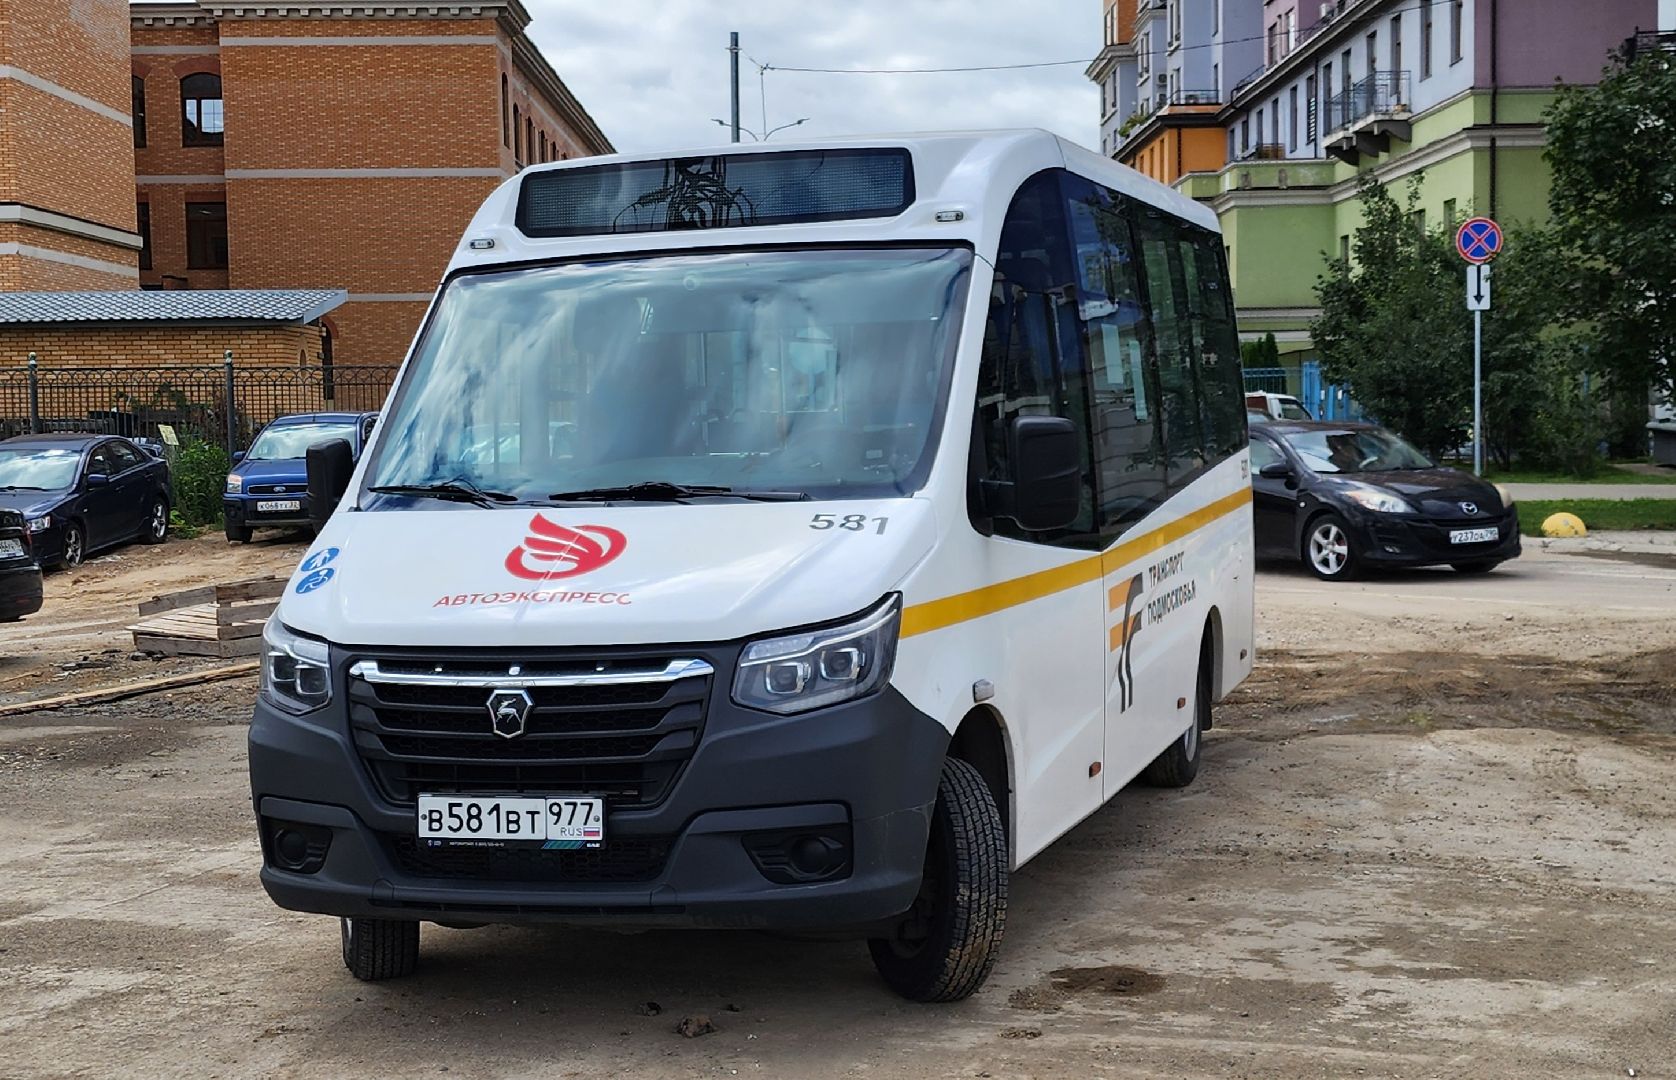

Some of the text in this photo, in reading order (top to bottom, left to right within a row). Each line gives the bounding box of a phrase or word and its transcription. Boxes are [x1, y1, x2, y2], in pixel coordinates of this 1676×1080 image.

[808, 514, 889, 535] 581
[1149, 551, 1184, 588] ТРАНСПОРТ
[433, 591, 632, 607] АВТОЭКСПРЕСС
[1148, 579, 1196, 625] ПОДМОСКОВЬЯ
[428, 802, 594, 834] В581ВТ 977
[560, 827, 582, 836] RUS
